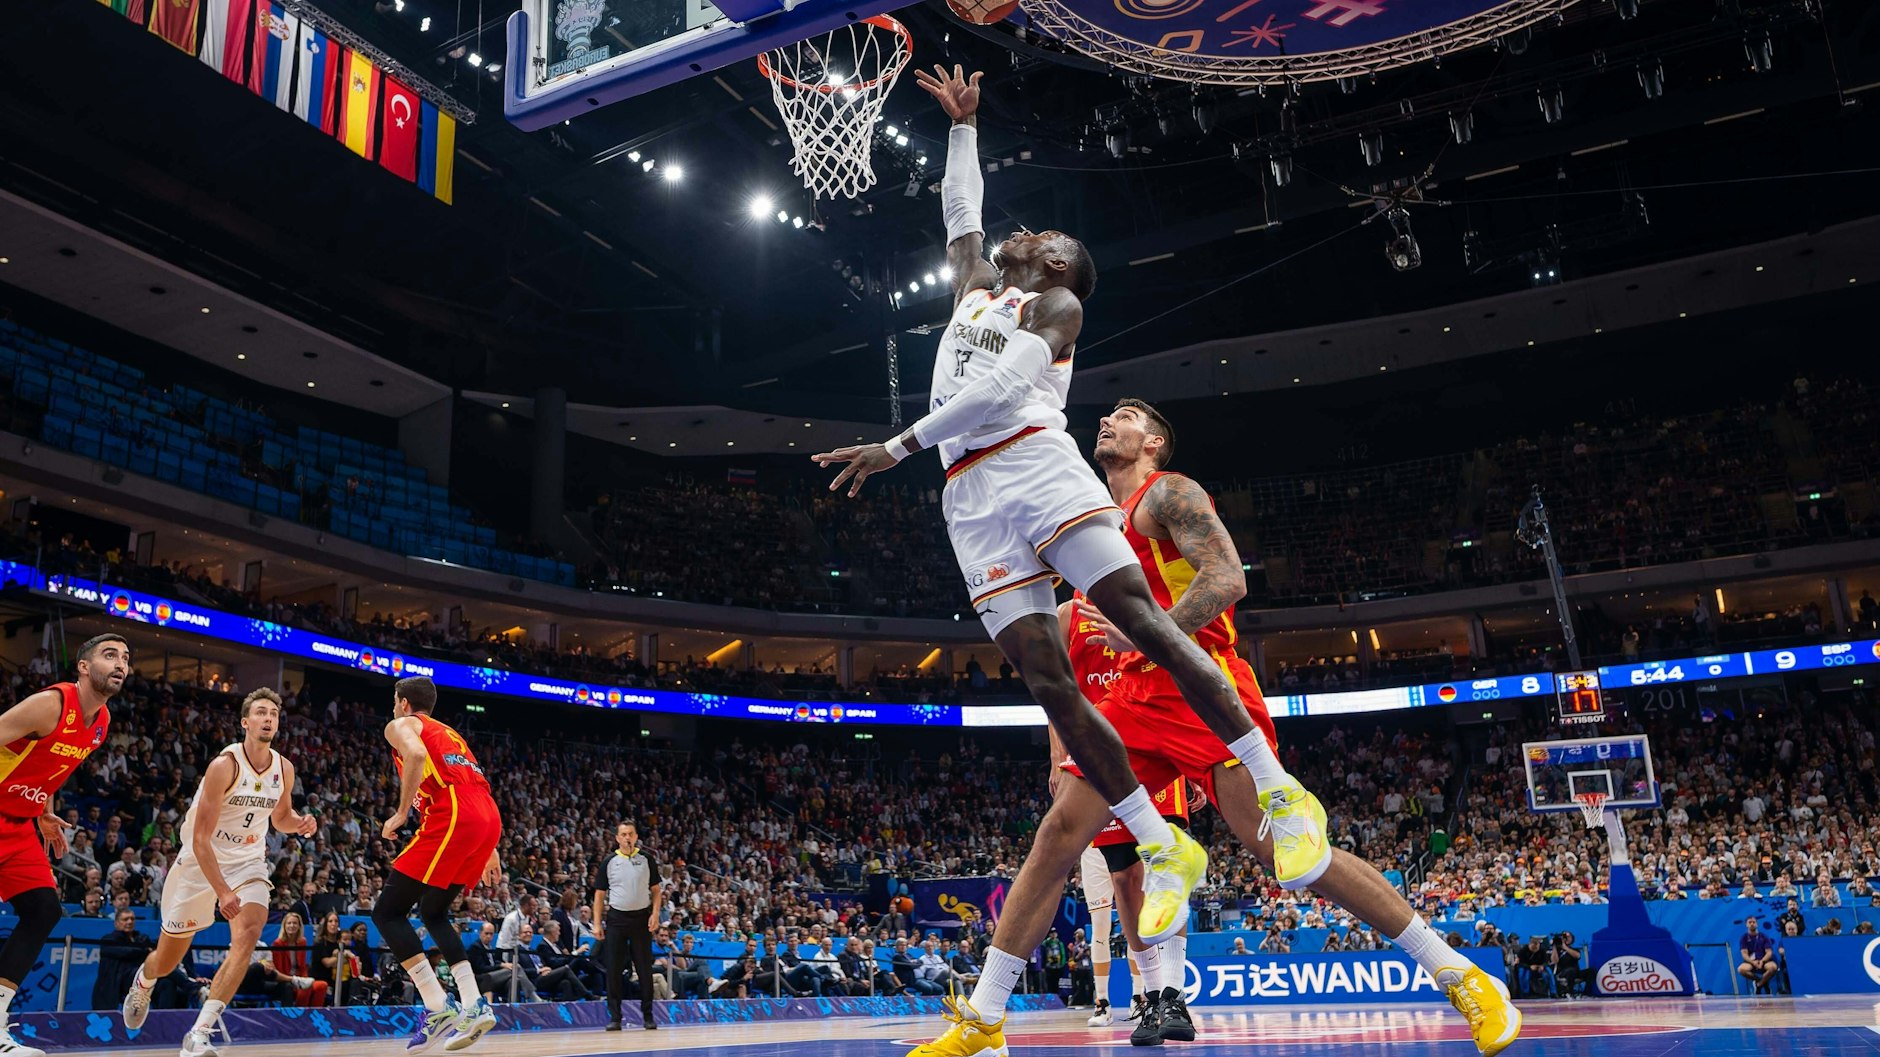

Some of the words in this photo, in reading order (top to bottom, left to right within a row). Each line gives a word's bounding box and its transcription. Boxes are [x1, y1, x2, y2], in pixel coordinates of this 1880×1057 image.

[134, 600, 152, 614] VS
[174, 611, 210, 628] SPAIN
[1822, 644, 1852, 655] ESP
[312, 642, 359, 660] GERMANY
[376, 656, 389, 667] VS
[405, 663, 434, 677] SPAIN
[1775, 651, 1796, 669] 9
[1631, 665, 1684, 685] 5:44
[1709, 664, 1722, 675] 0
[1472, 679, 1498, 690] GER
[1522, 677, 1540, 694] 8
[529, 683, 575, 696] GERMANY
[592, 691, 605, 700] VS
[624, 695, 655, 705] SPAIN
[1573, 690, 1598, 712] 17
[1641, 688, 1686, 711] 201
[748, 705, 793, 715] GERMANY
[813, 708, 828, 716] VS
[846, 709, 876, 717] SPAIN
[48, 764, 69, 780] 7
[243, 812, 255, 828] 9
[216, 829, 244, 844] ING
[167, 920, 185, 929] ING
[1608, 961, 1655, 975] 百岁山
[1207, 962, 1290, 998] 万达
[1289, 960, 1440, 994] WANDA
